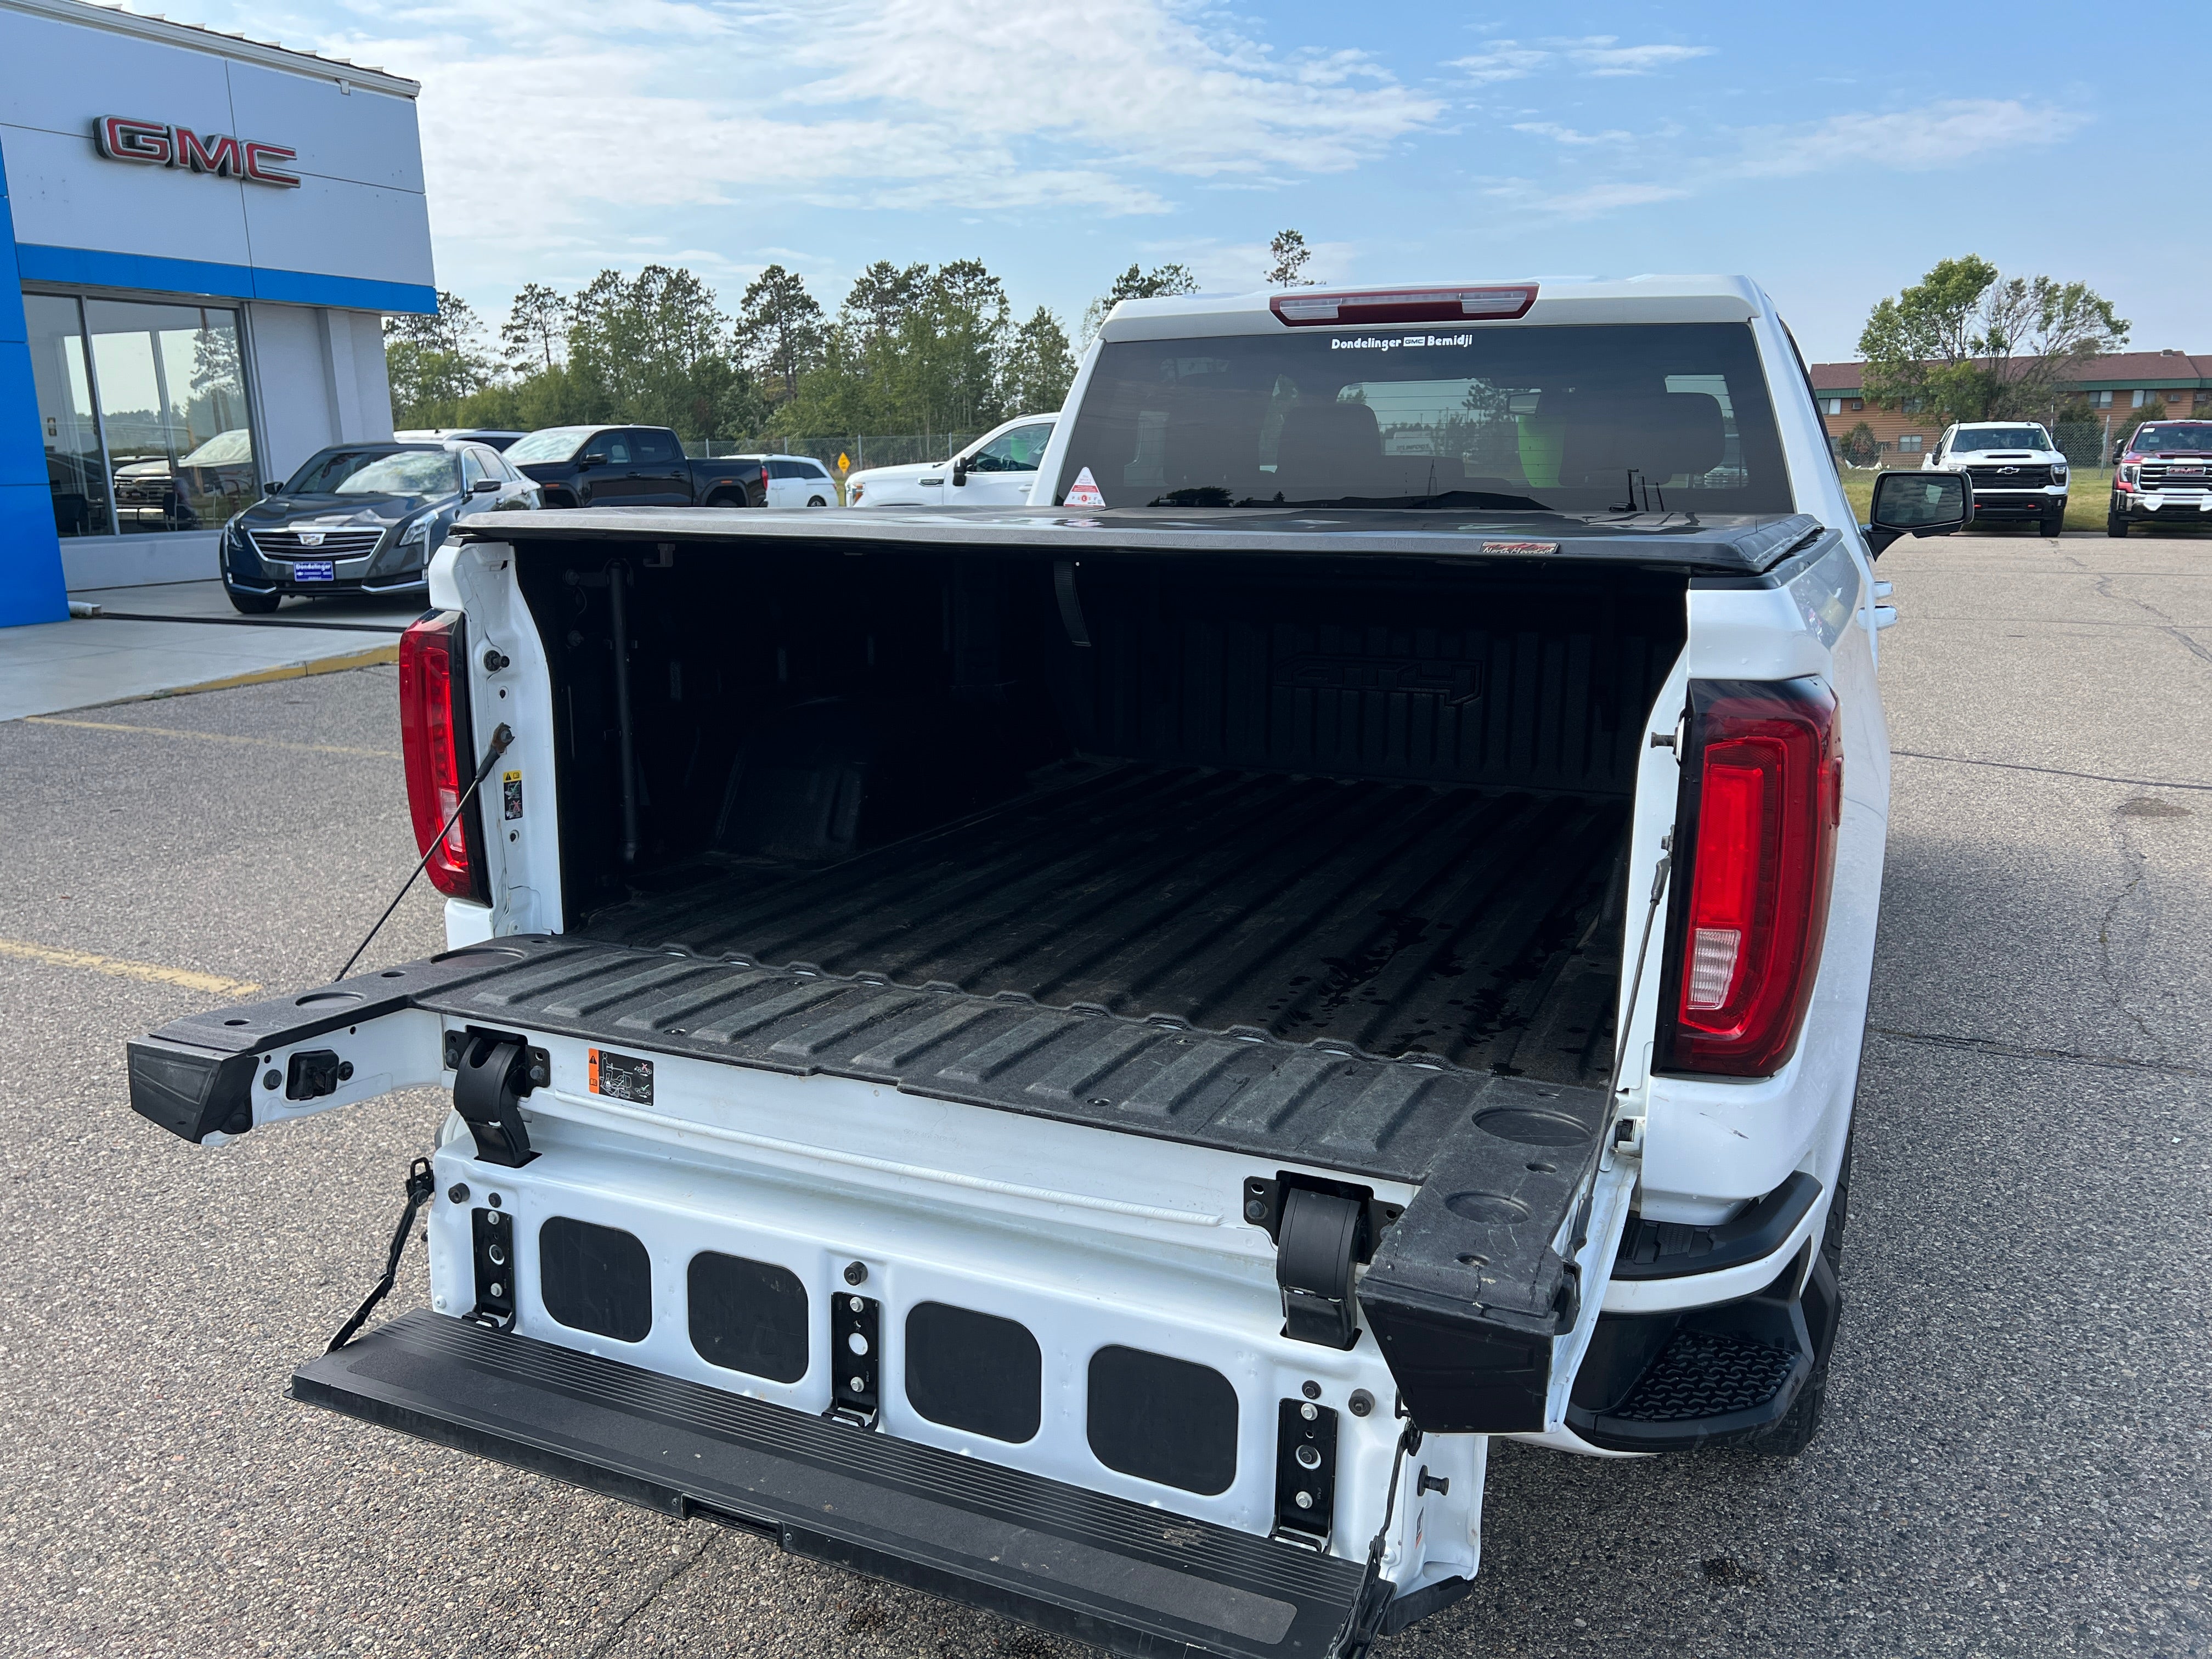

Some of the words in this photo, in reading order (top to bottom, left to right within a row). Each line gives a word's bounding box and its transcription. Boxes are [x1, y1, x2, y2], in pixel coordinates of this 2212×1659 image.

[93, 114, 301, 188] GMC
[1331, 338, 1402, 352] Dondelinger
[1404, 337, 1425, 346] GMC
[1427, 334, 1473, 348] Bemidji
